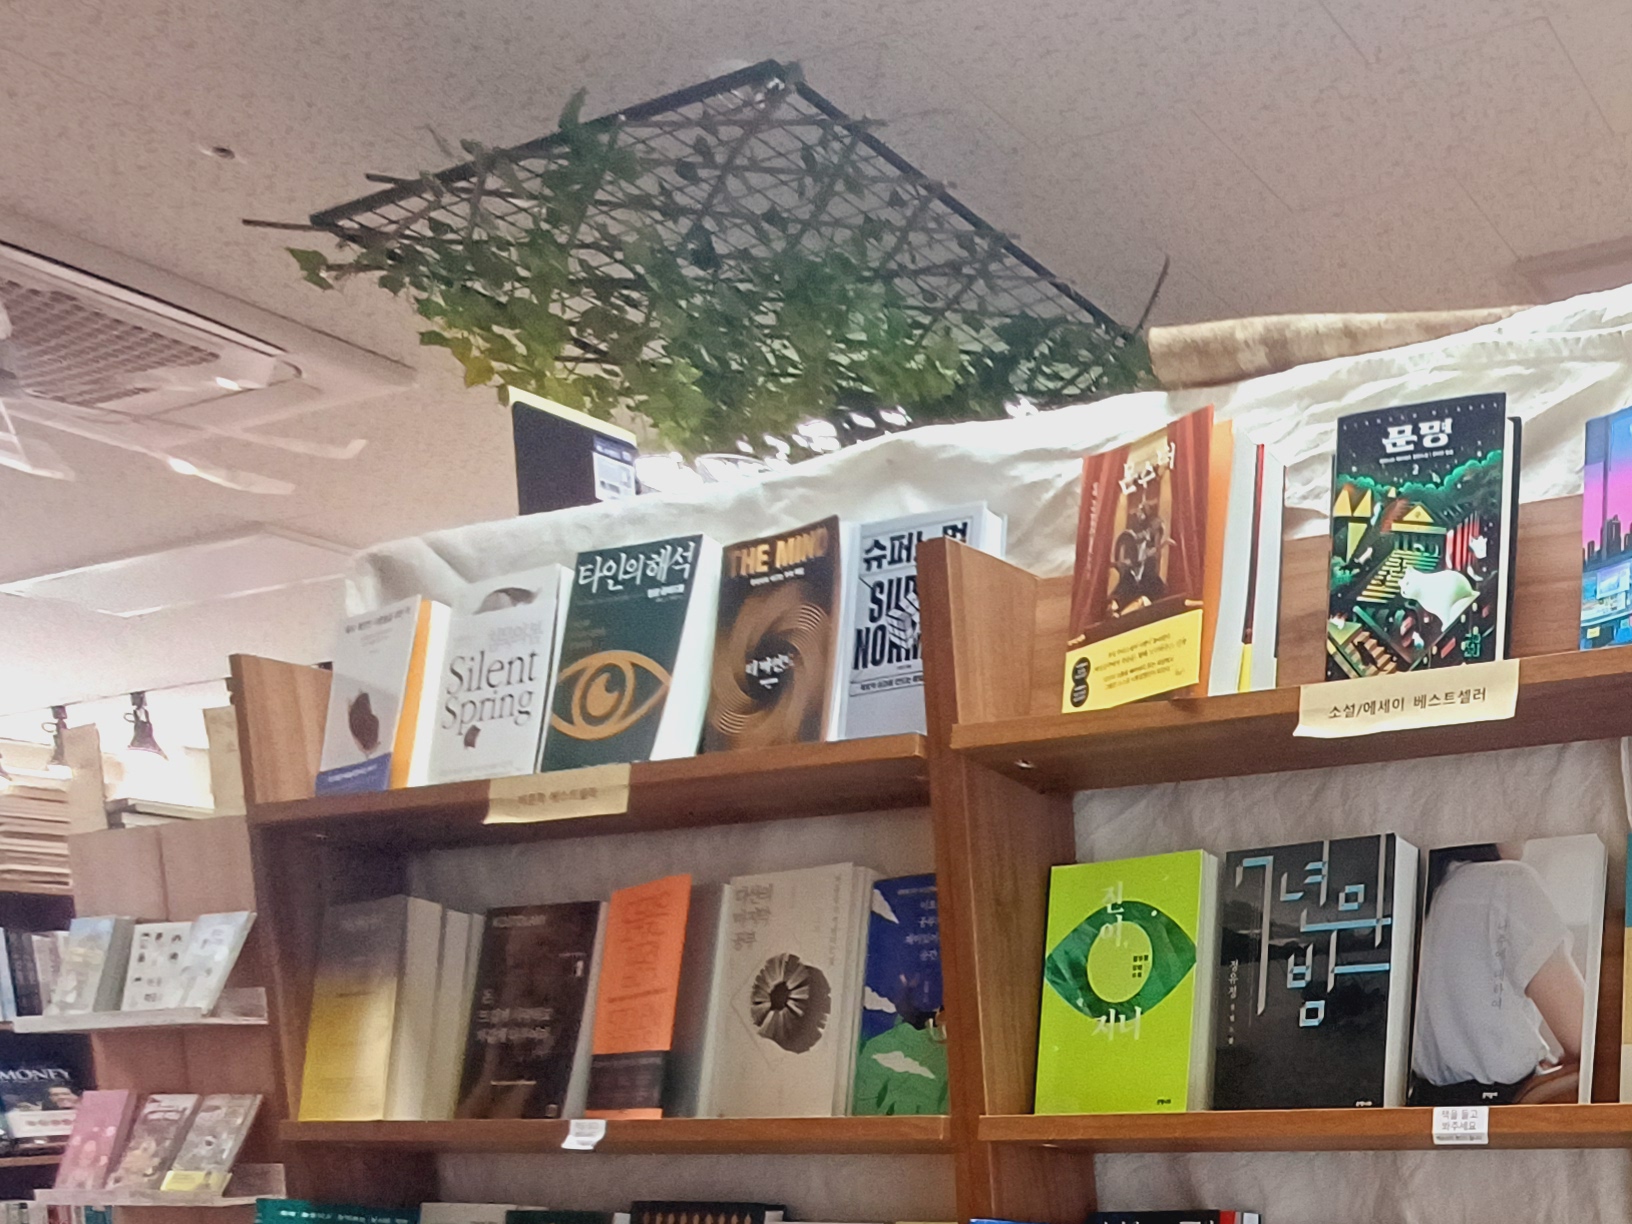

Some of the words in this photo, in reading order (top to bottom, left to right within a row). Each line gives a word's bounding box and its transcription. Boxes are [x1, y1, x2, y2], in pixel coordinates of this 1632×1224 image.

[1381, 417, 1453, 454] 문명
[731, 543, 771, 578] THE
[446, 648, 540, 698] Silent
[441, 688, 535, 737] Spring
[1328, 695, 1406, 721] 소설/에세이
[1412, 686, 1488, 711] 베스트셀러
[1090, 1005, 1143, 1041] 지니
